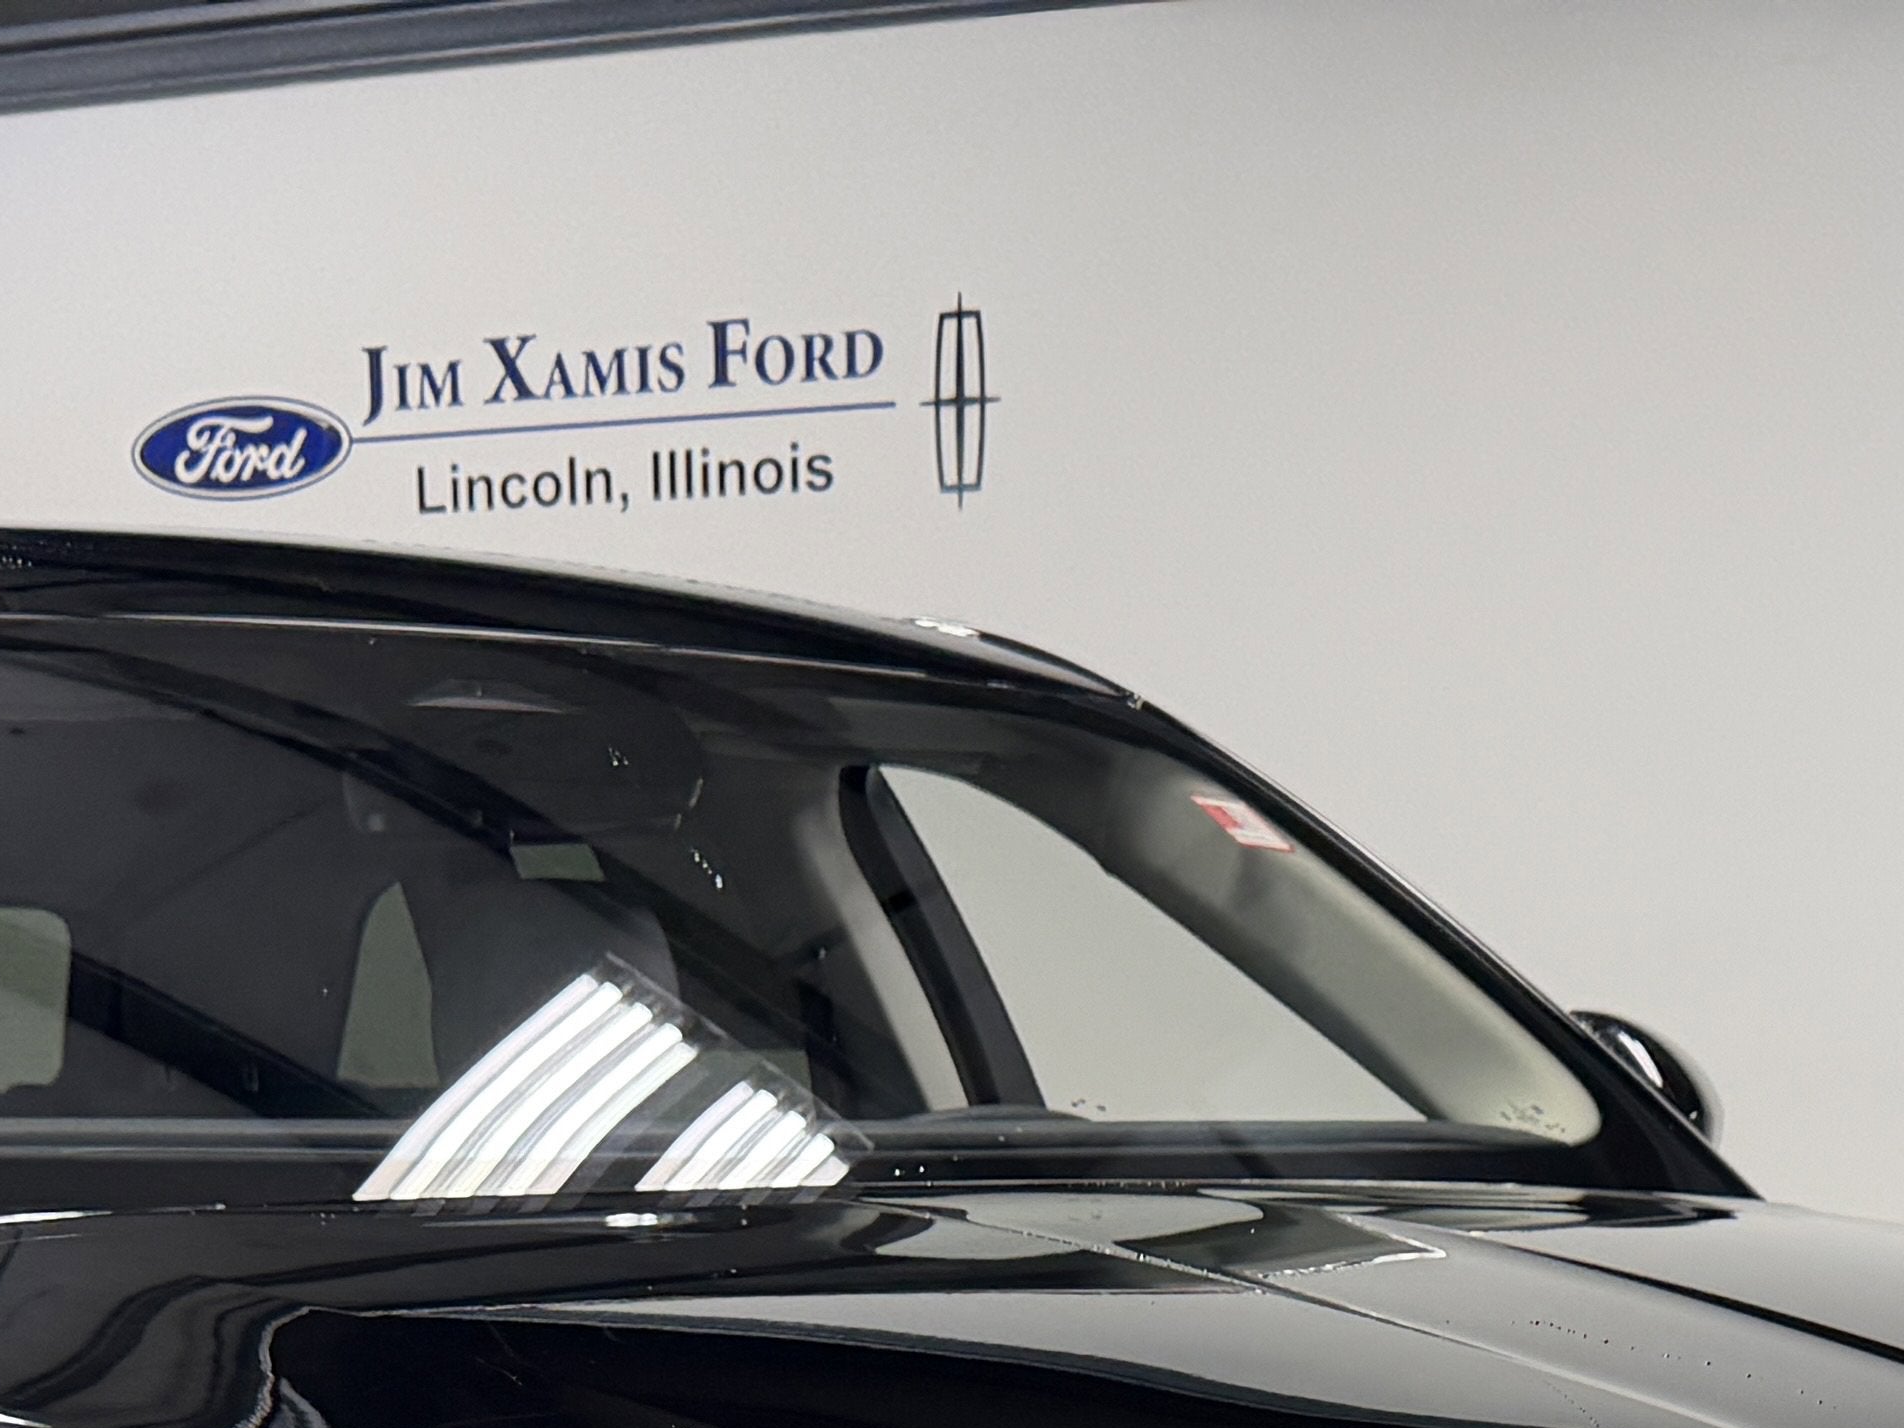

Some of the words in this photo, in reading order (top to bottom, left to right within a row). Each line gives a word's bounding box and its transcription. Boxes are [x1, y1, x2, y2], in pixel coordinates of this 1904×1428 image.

[708, 318, 884, 389] FORD
[175, 414, 306, 485] Ford
[417, 456, 629, 513] Lincoln,
[652, 443, 835, 501] Illinois
